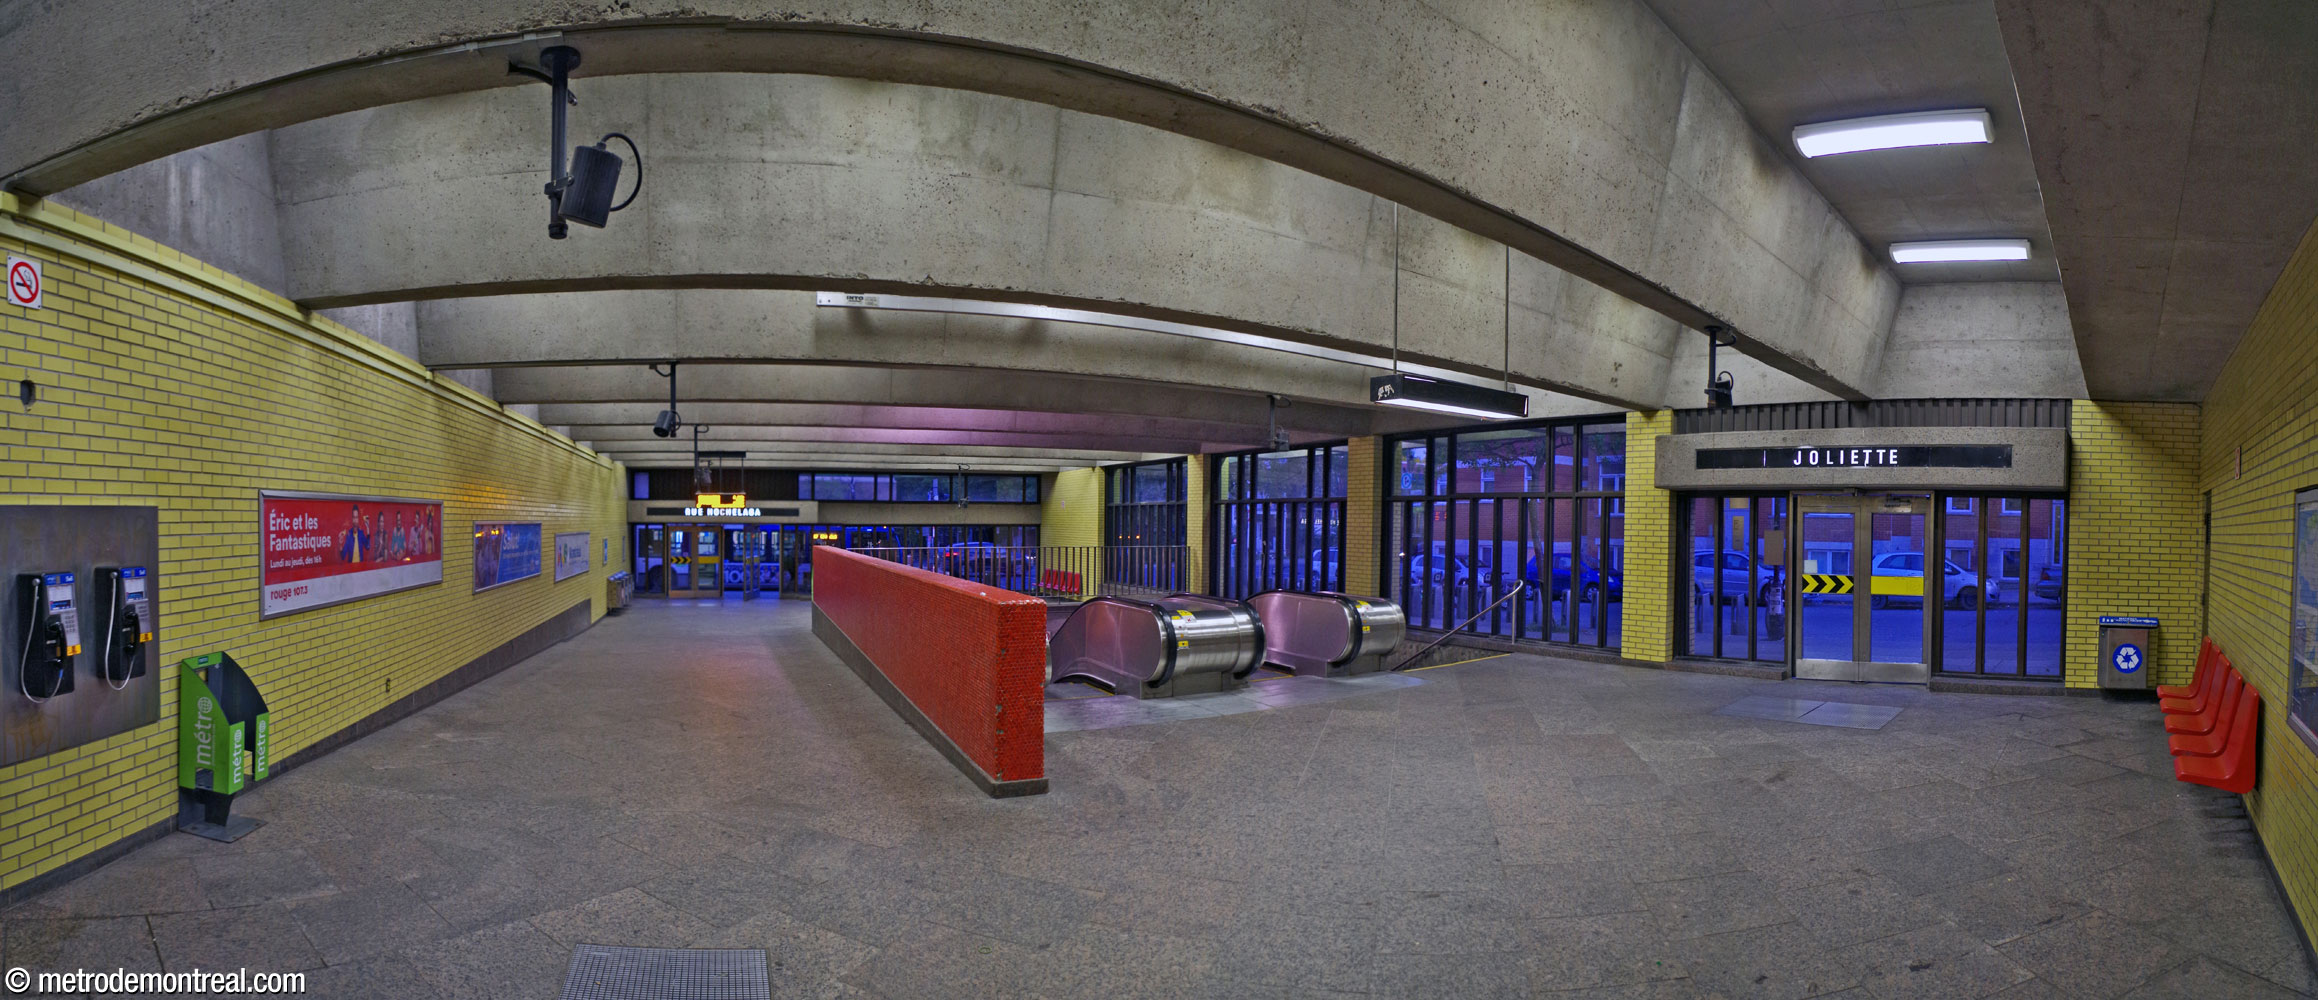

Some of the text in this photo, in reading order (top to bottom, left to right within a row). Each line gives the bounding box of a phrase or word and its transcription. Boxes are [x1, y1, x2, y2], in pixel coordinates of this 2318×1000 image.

[1793, 449, 1898, 466] JOLIETTE
[269, 508, 318, 531] Éric et les
[685, 508, 761, 516] RUE HOCHELAGA
[269, 532, 332, 552] Fantastiques
[270, 558, 284, 569] Lundi
[270, 585, 308, 601] rouge 107.3
[194, 696, 213, 766] métro
[256, 720, 266, 772] métro
[233, 729, 242, 784] métro
